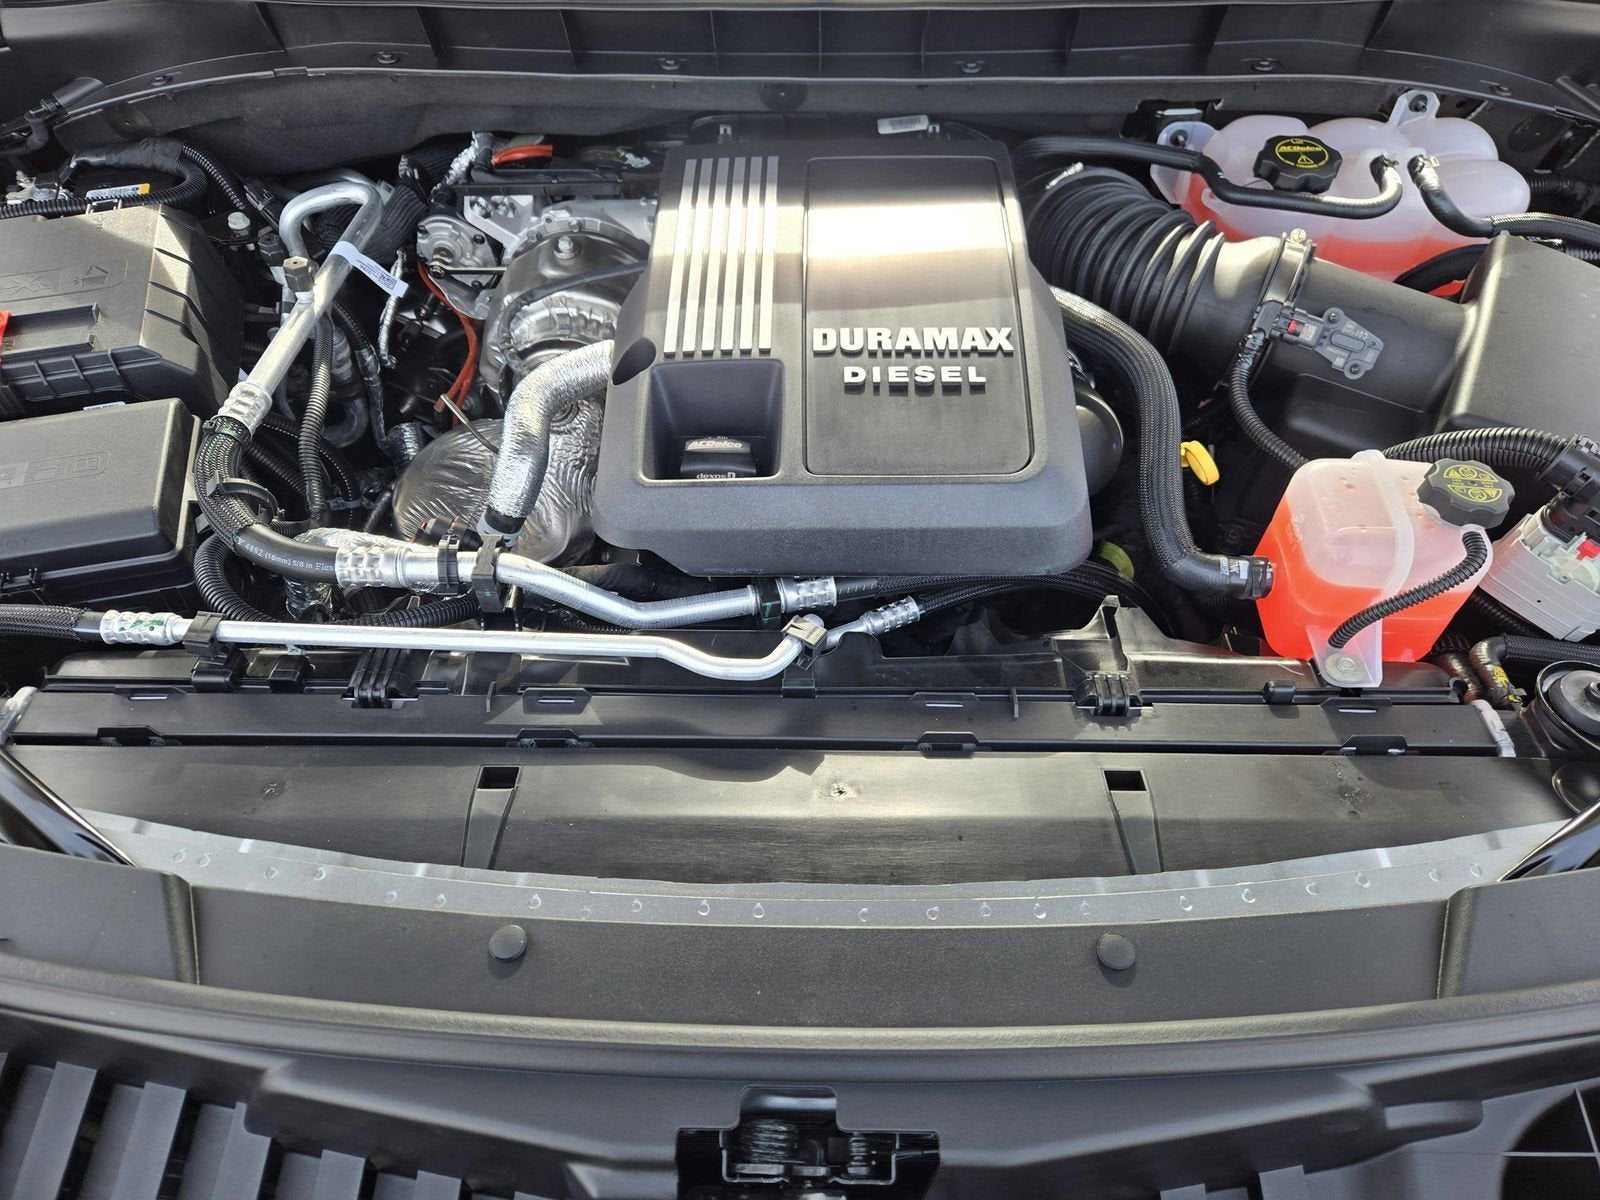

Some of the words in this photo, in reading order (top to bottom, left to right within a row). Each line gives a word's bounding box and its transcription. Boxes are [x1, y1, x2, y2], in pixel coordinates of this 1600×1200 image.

[812, 327, 1014, 353] DURAMAX
[843, 365, 986, 386] DIESEL
[686, 440, 743, 450] ACDelco
